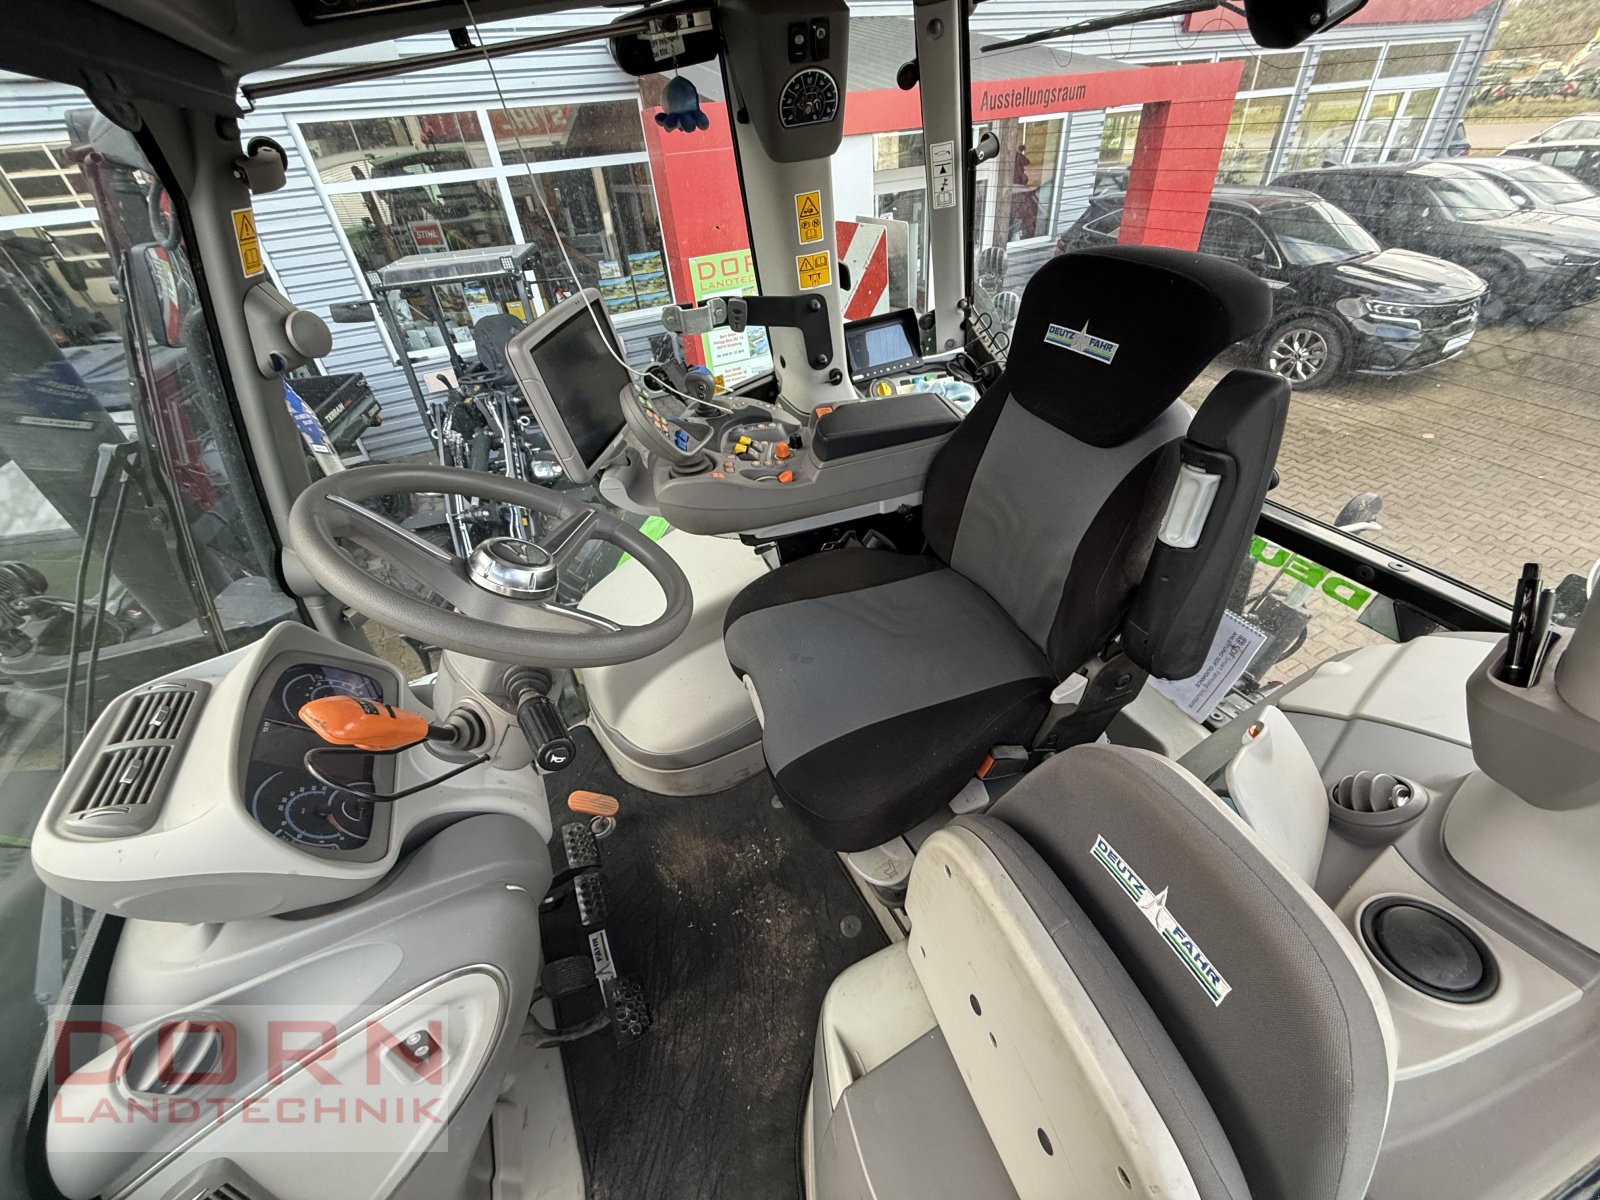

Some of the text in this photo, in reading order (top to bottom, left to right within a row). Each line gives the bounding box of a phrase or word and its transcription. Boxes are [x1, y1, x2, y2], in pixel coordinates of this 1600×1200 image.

[980, 84, 1087, 112] Ausstellungsraum
[415, 230, 439, 239] STIHL
[1049, 326, 1114, 352] DEUTZ FAHR
[1228, 643, 1241, 659] SDF
[1195, 665, 1214, 688] GUIDANCE
[1097, 840, 1221, 986] DEUTZ FAHR
[592, 937, 603, 962] FAHR
